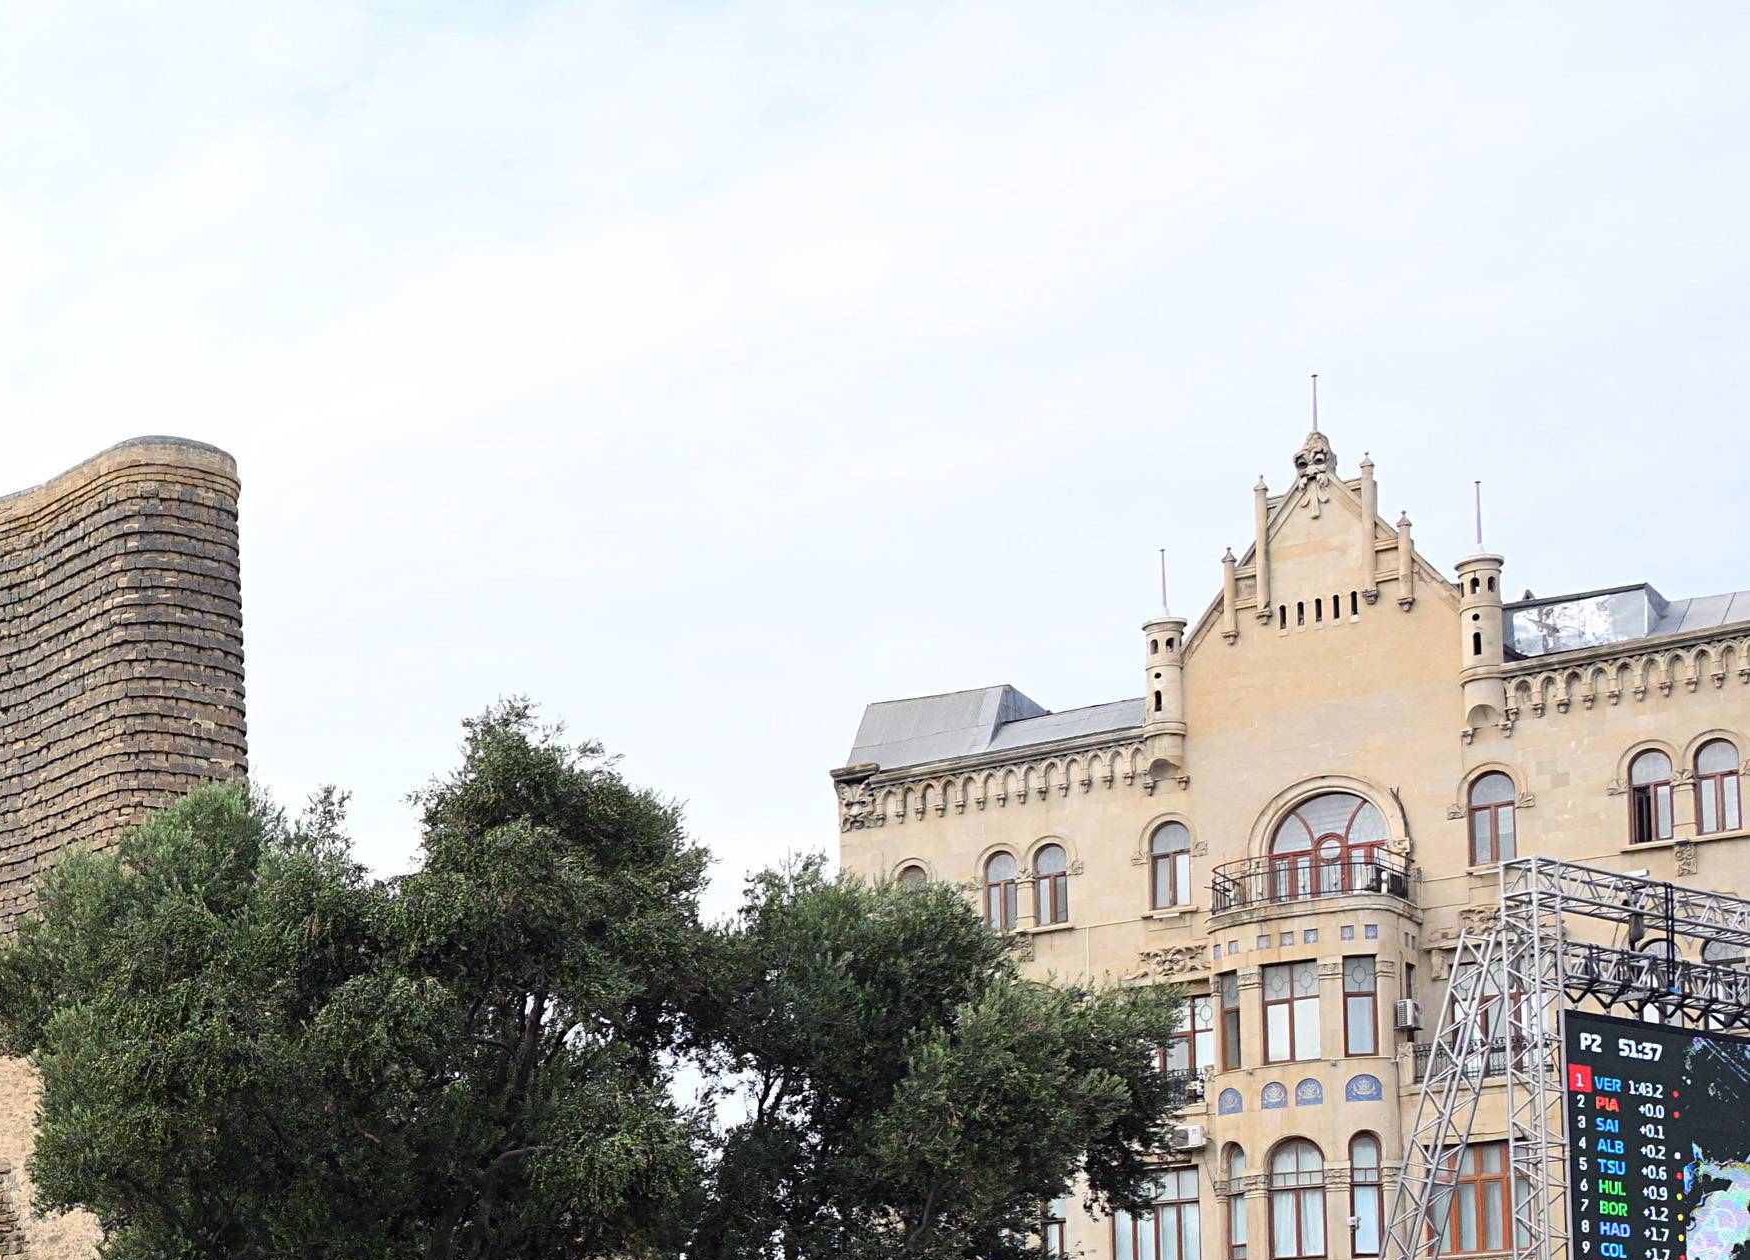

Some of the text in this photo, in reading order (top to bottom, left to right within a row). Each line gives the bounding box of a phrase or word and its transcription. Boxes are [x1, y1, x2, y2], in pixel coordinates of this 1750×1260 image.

[1580, 1033, 1662, 1061] P2 51:37
[1576, 1074, 1663, 1098] 1 VER 1:43.2
[1577, 1094, 1665, 1118] 2 PIA +0.0
[1578, 1116, 1665, 1139] 3 SAI +0.1
[1579, 1137, 1666, 1159] 4 ALB +0.2
[1579, 1157, 1667, 1180] 5 TSU +0.6
[1580, 1179, 1667, 1200] 6 HUL +0.9
[1581, 1199, 1668, 1221] 7 BOR +1.2
[1581, 1220, 1669, 1241] 8 HAD +1.7
[1582, 1241, 1590, 1253] 9
[1600, 1242, 1627, 1258] COL
